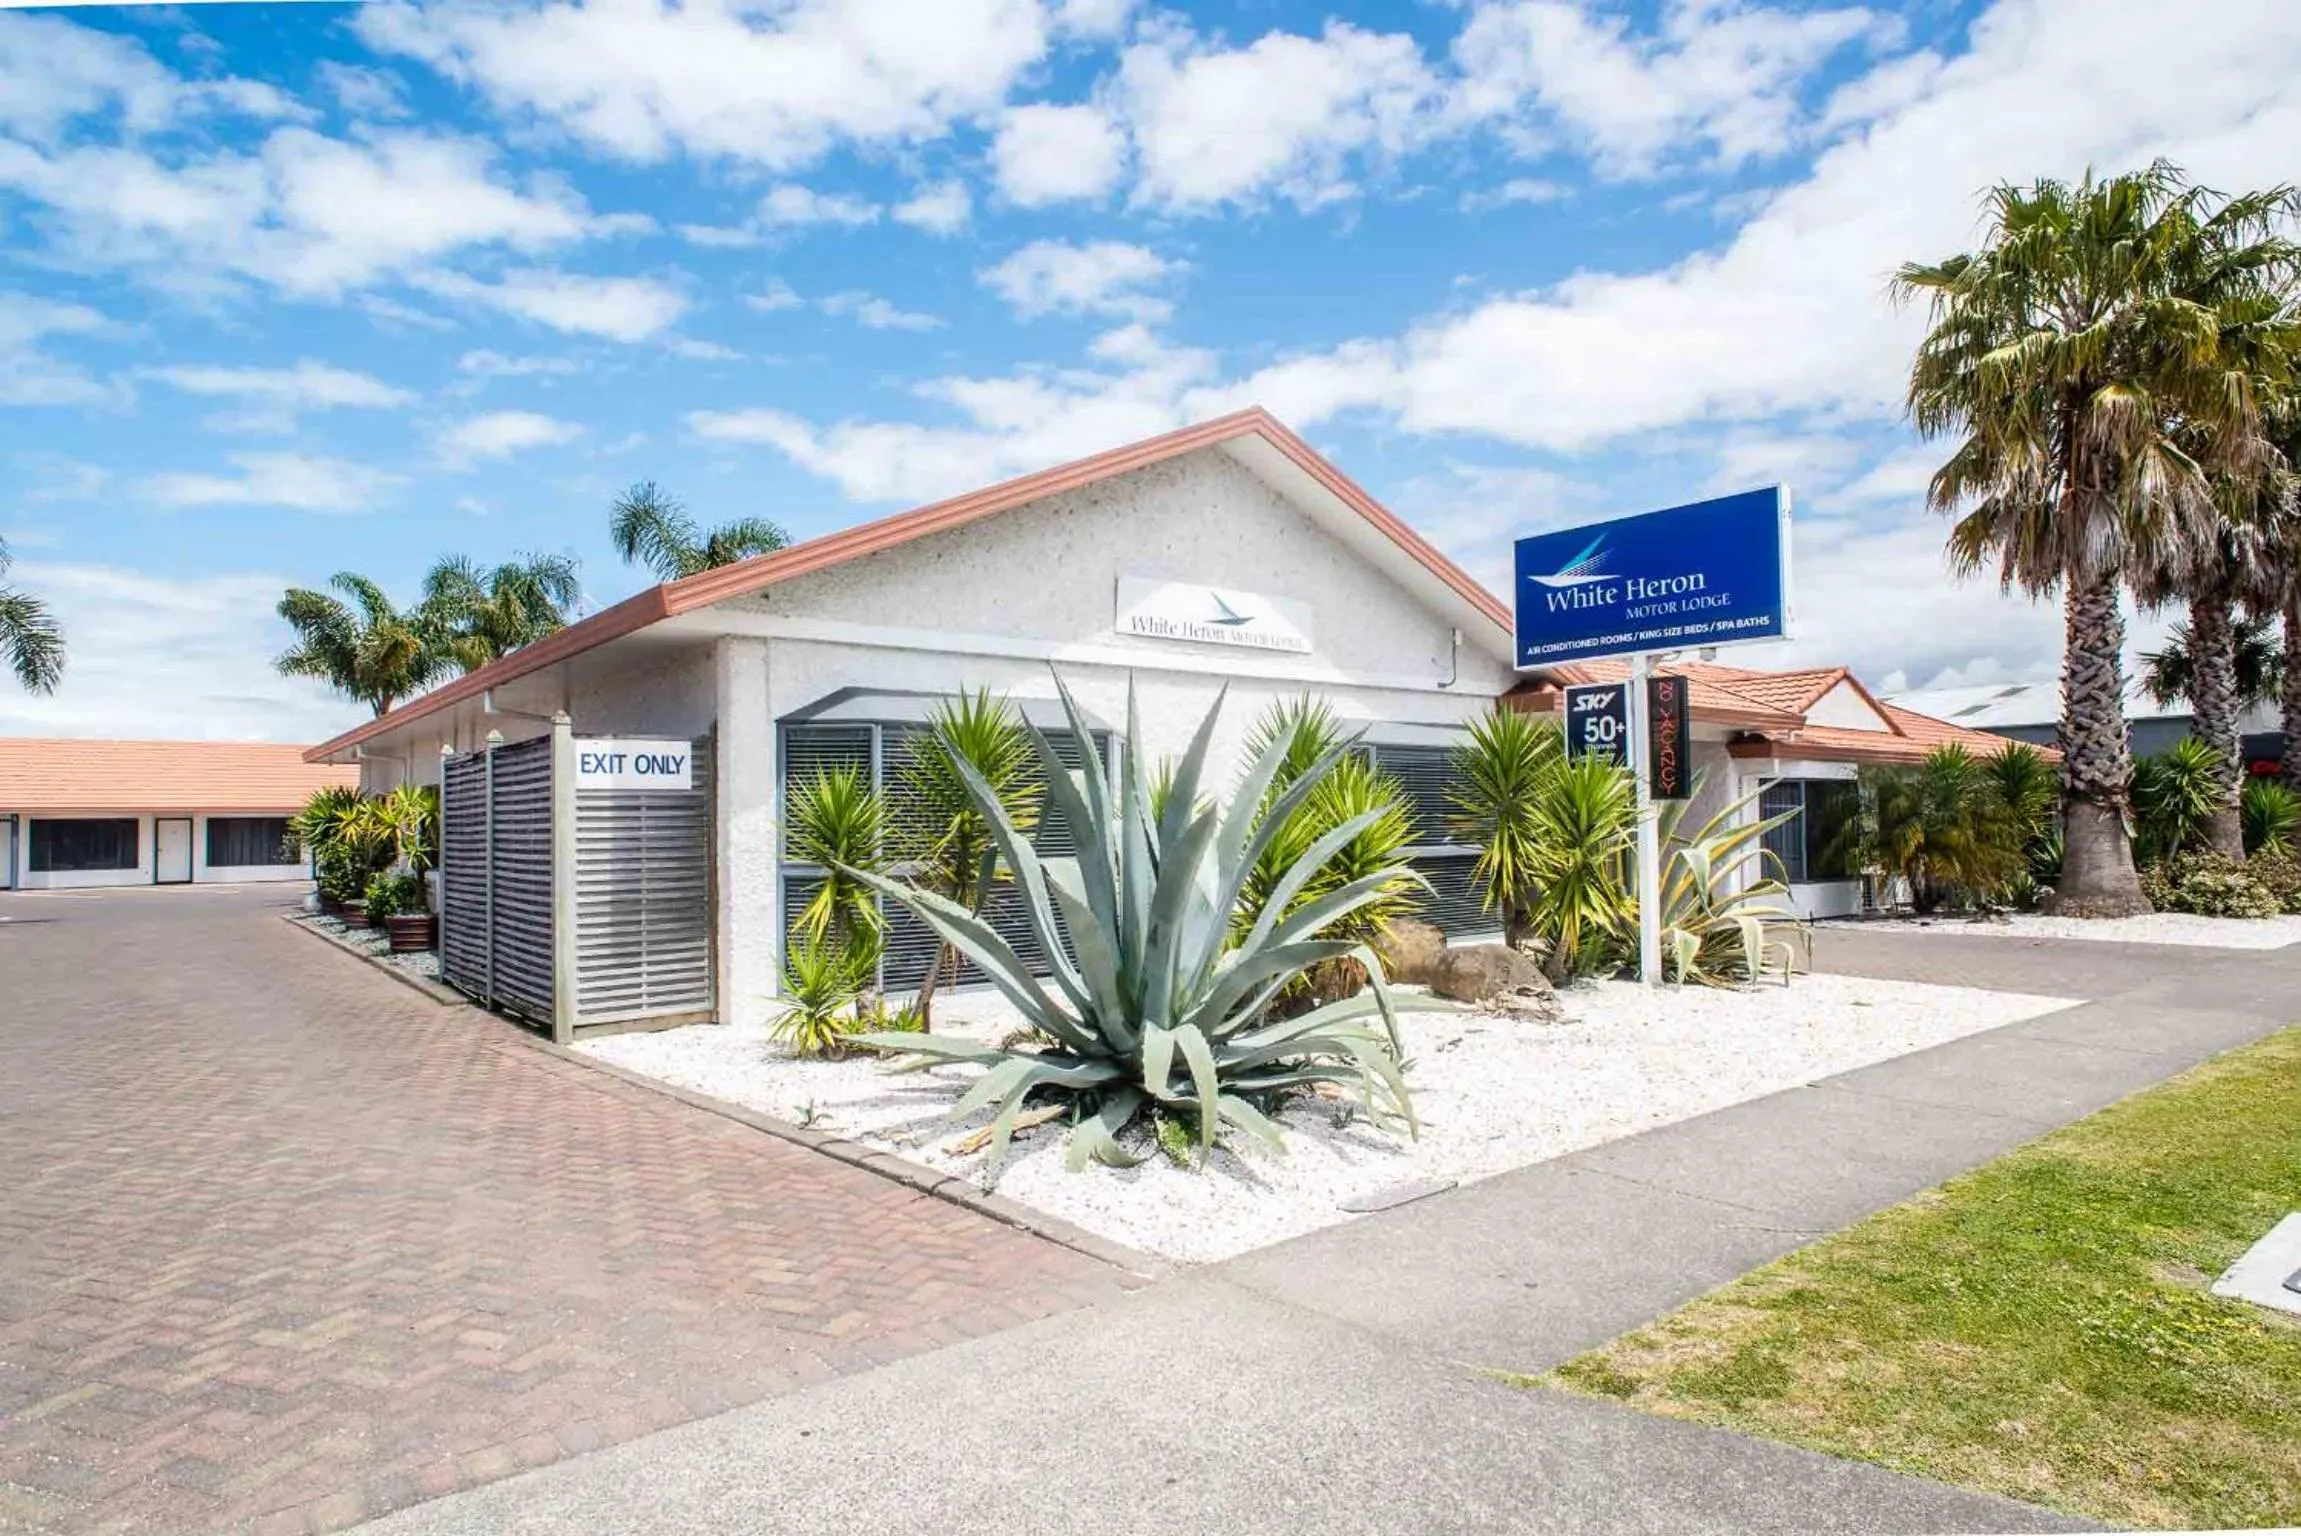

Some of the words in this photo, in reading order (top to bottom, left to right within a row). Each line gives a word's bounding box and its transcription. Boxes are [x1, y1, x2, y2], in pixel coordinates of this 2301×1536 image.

[1546, 585, 1618, 613] White
[1626, 572, 1706, 601] Heron
[1625, 601, 1678, 620] MOTOR
[1681, 593, 1731, 612] LODGE
[1130, 615, 1178, 636] White
[1183, 621, 1226, 642] Heron
[1527, 645, 1540, 655] AIR
[1541, 637, 1599, 653] CONDITIONED
[1600, 632, 1633, 646] ROOMS
[1639, 628, 1662, 641] KING
[1663, 626, 1682, 637] SIZE
[1684, 623, 1709, 635] BEDS
[1716, 619, 1735, 632] SPA
[1736, 615, 1770, 629] BATHS
[1572, 691, 1617, 713] SKY
[1584, 715, 1626, 742] 50+
[580, 753, 627, 774] EXIT
[634, 754, 685, 774] ONLY
